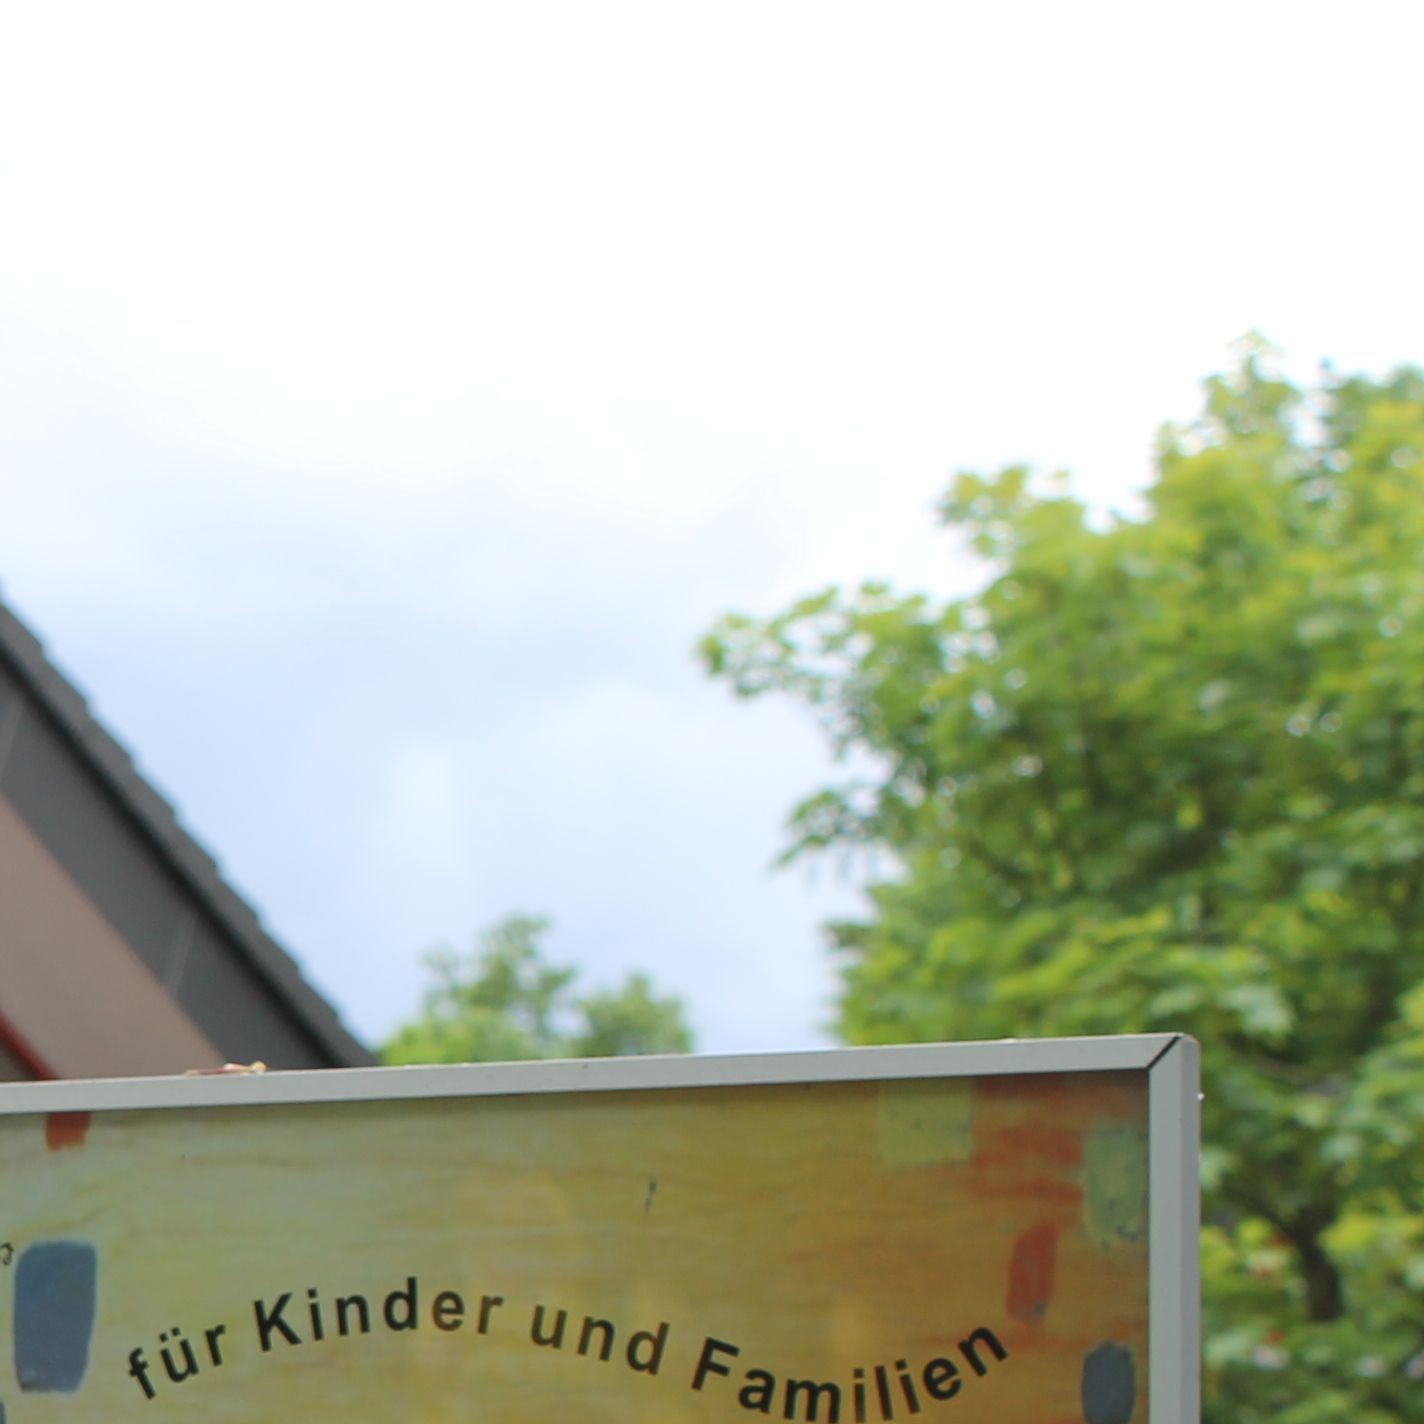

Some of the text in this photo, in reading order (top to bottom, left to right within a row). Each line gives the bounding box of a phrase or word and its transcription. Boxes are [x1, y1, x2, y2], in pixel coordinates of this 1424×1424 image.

[126, 1321, 227, 1400] für
[251, 1276, 505, 1353] Kinder
[528, 1301, 670, 1376] und
